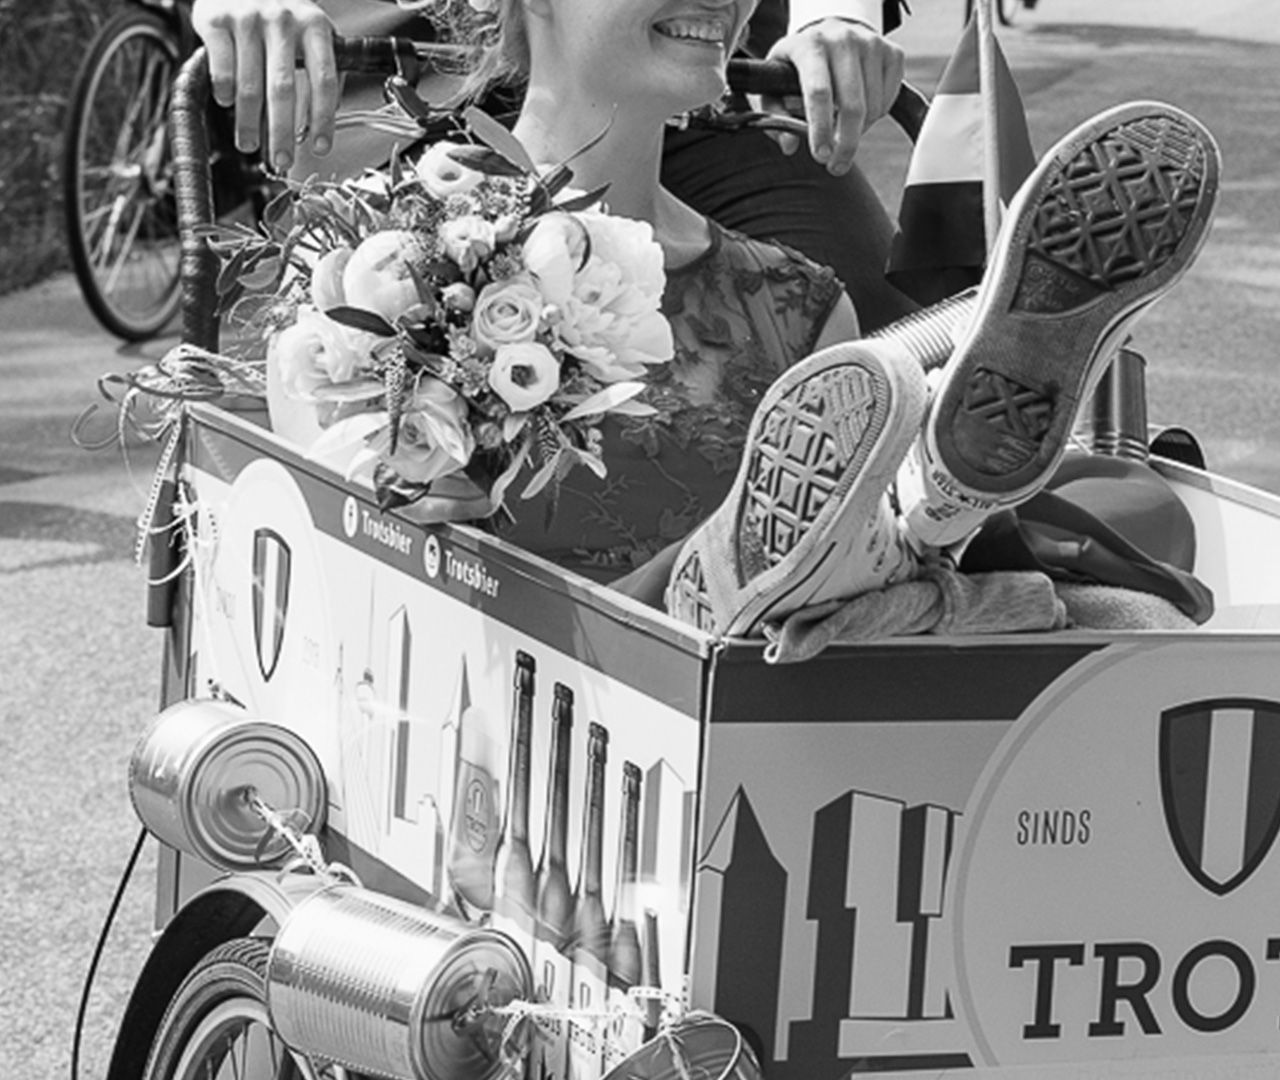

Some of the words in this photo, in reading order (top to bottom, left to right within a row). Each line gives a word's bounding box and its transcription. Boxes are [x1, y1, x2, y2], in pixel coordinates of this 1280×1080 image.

[361, 509, 413, 556] Trotsbier
[444, 549, 500, 598] Trotsbier
[1016, 809, 1091, 846] SINDS
